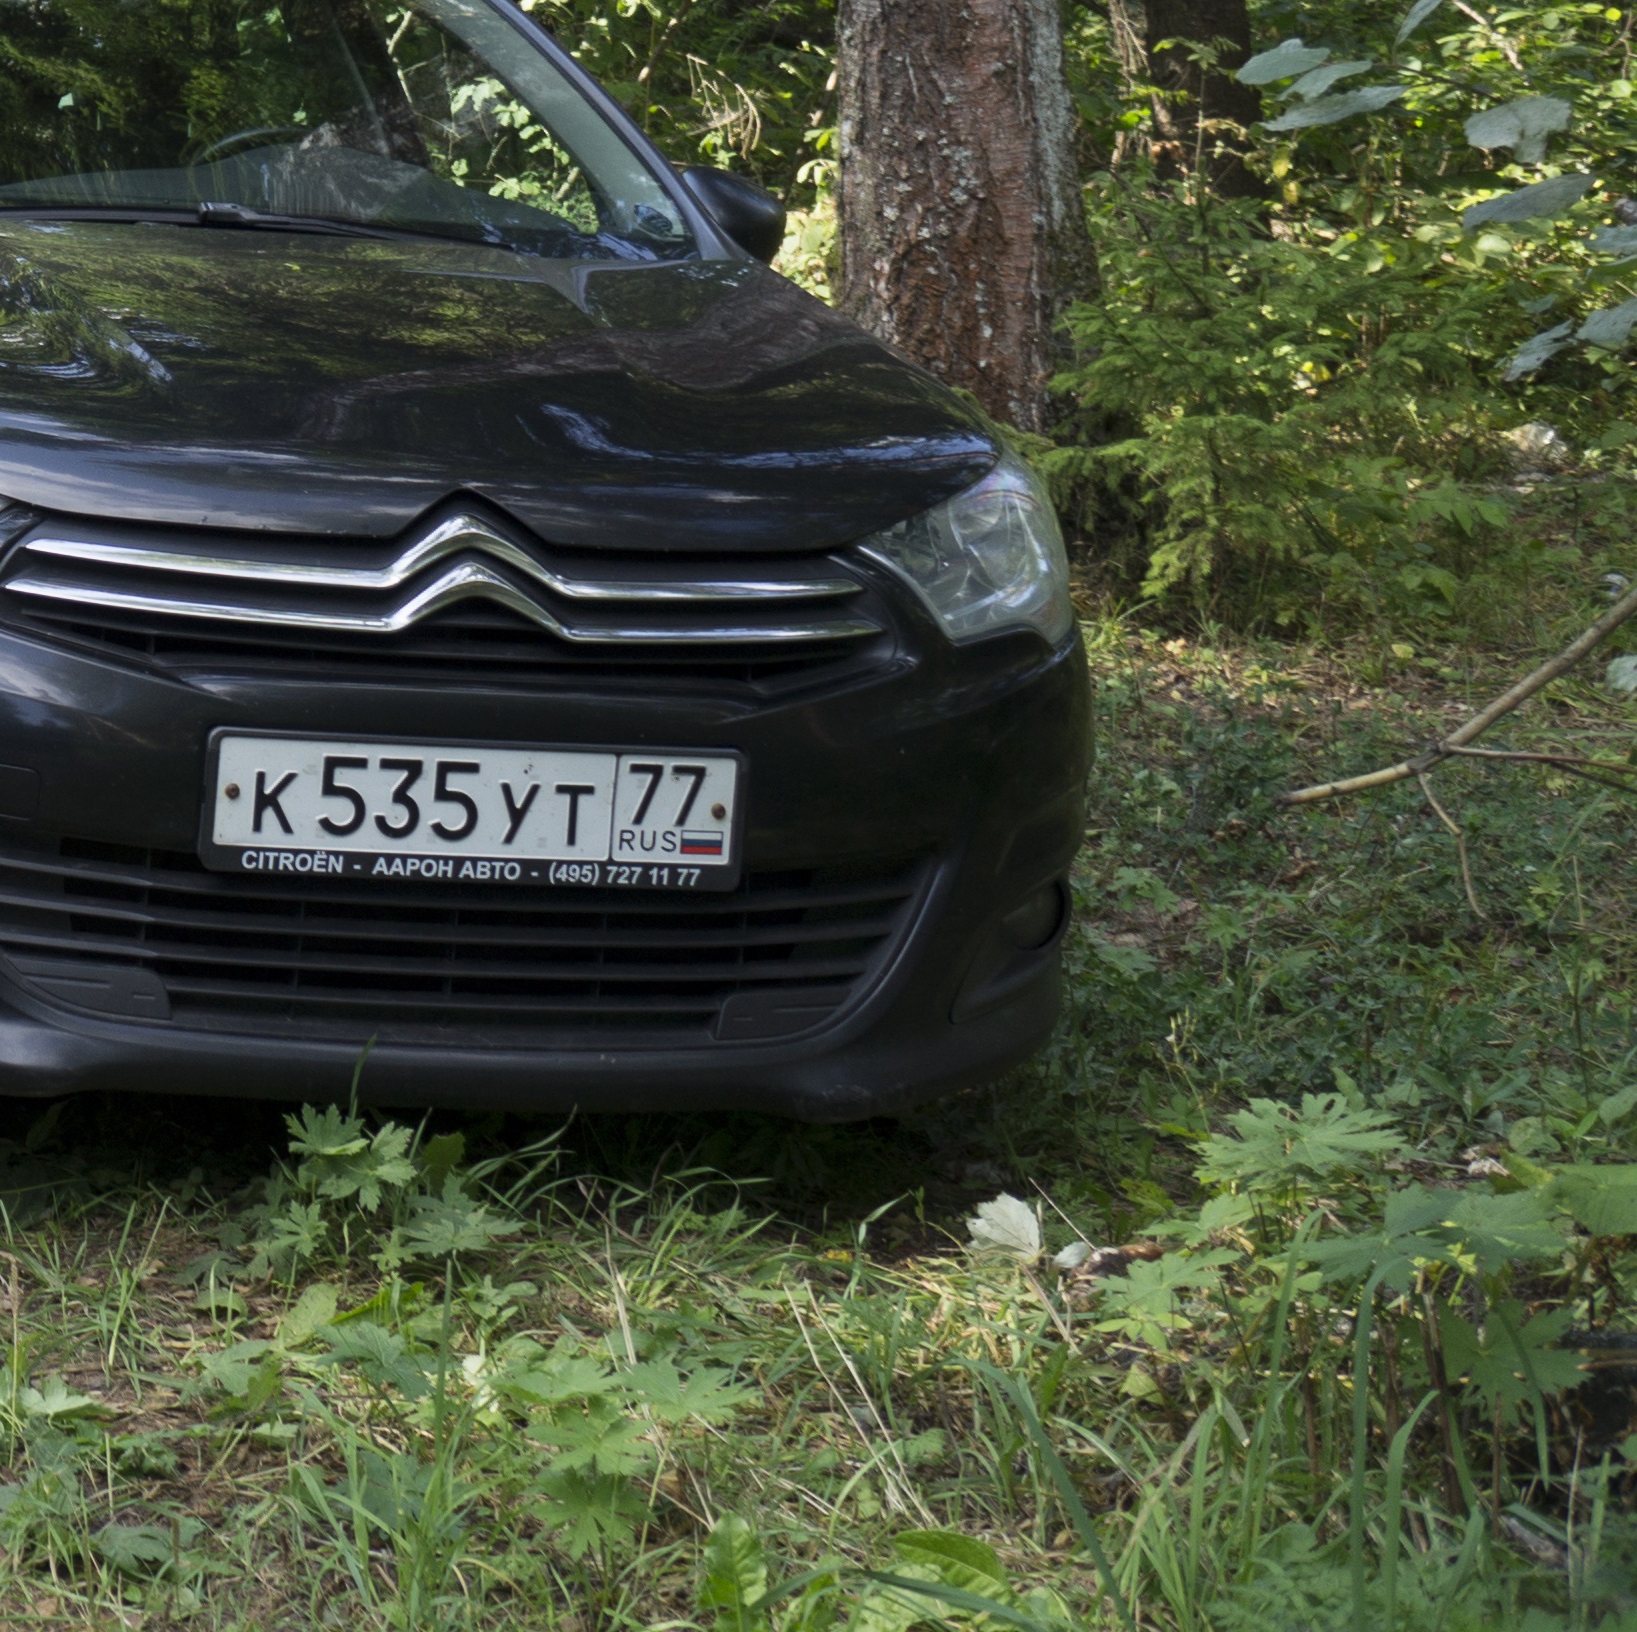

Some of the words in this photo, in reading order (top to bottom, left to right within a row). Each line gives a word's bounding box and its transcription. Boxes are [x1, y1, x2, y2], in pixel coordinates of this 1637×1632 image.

[627, 763, 707, 828] 77
[618, 829, 677, 853] RUS
[241, 850, 344, 873] CITROËN
[548, 861, 600, 886] (495)
[606, 866, 643, 885] 727
[649, 867, 668, 886] 11
[677, 868, 701, 887] 77
